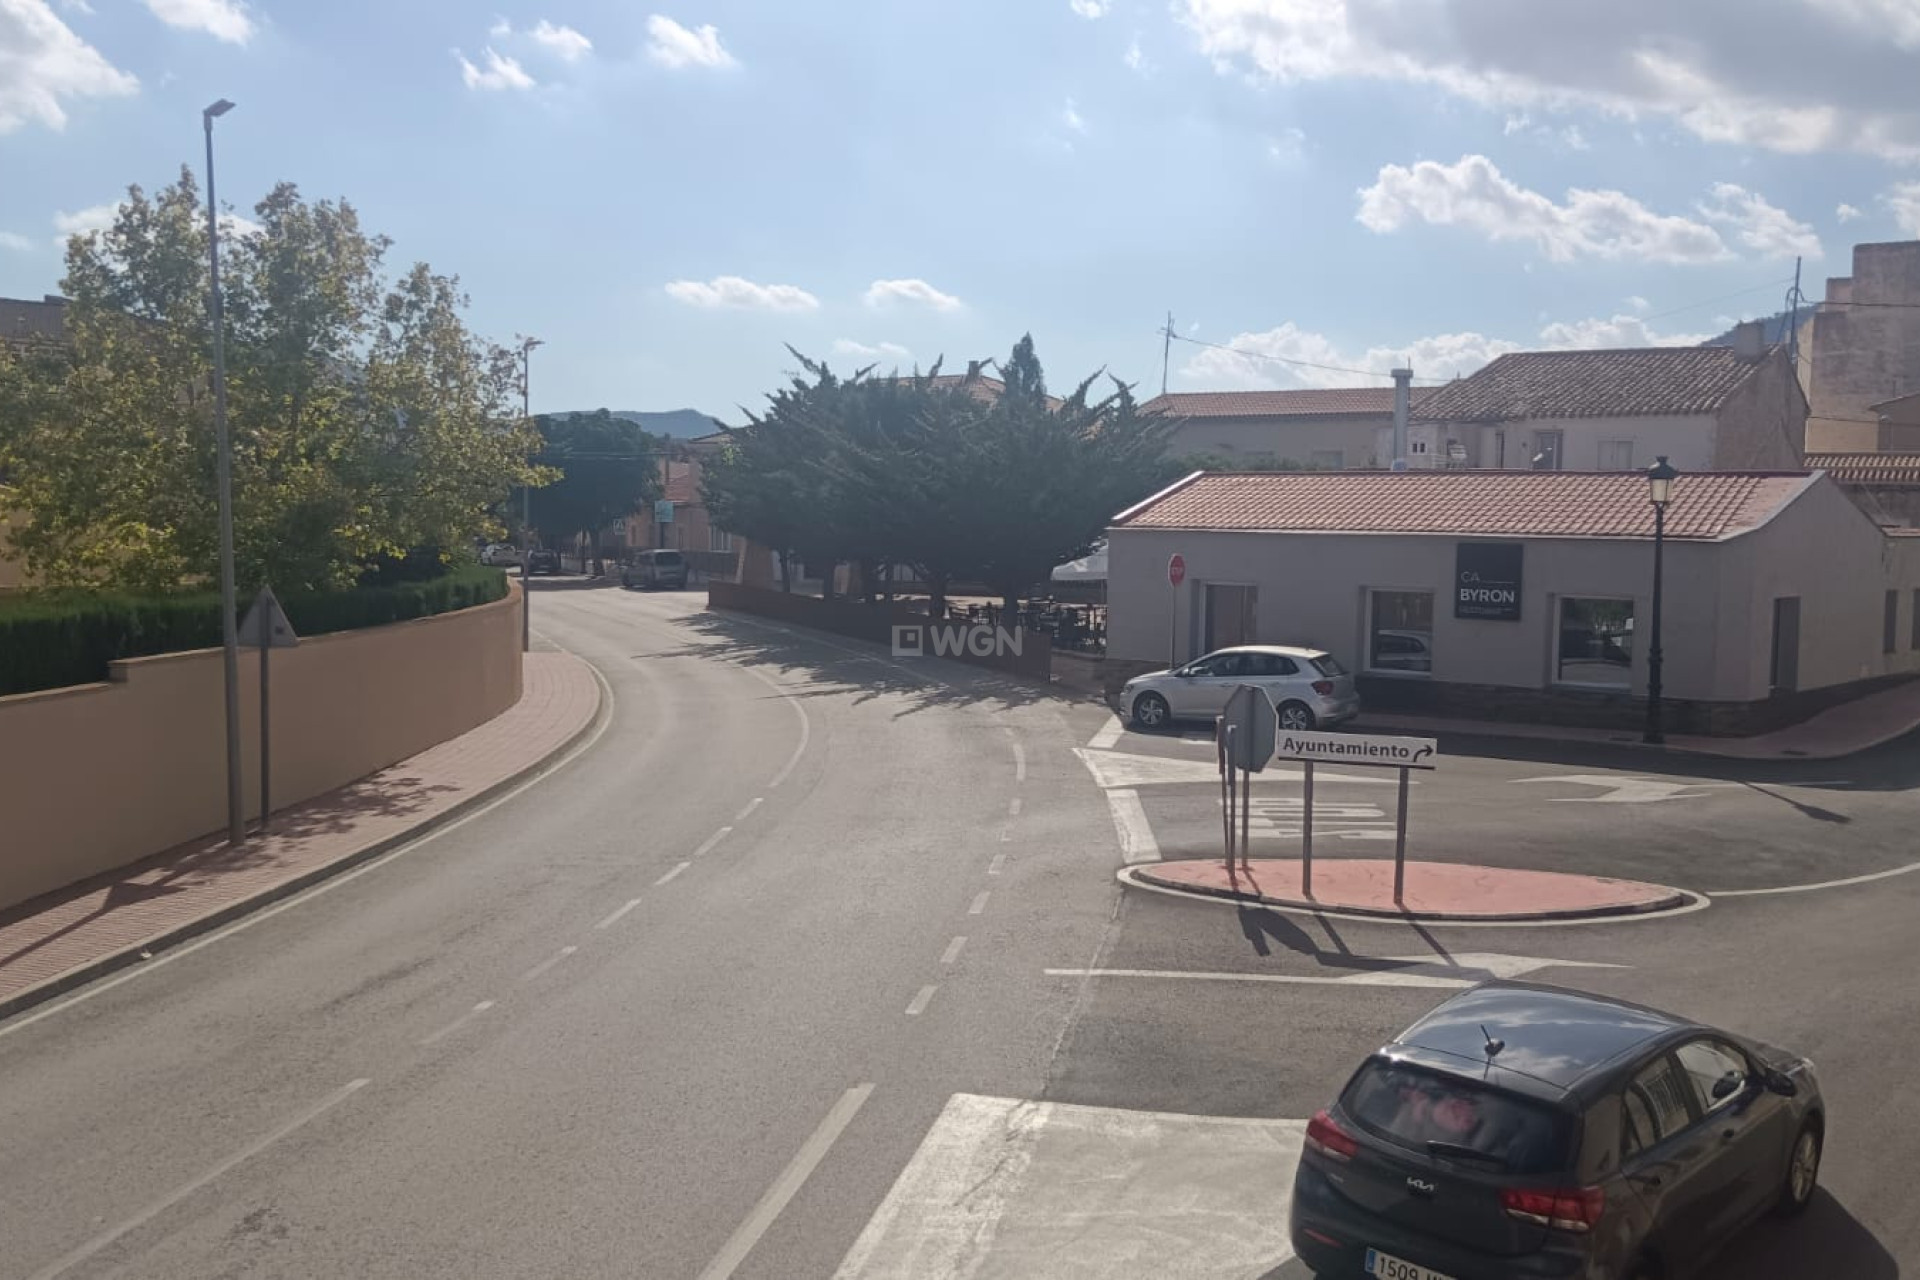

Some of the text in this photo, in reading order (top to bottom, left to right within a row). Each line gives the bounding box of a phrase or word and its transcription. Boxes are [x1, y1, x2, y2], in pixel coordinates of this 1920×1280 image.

[1460, 588, 1515, 603] BYRON
[1283, 737, 1409, 758] Ayuntamiento
[1380, 1256, 1418, 1280] 1509
